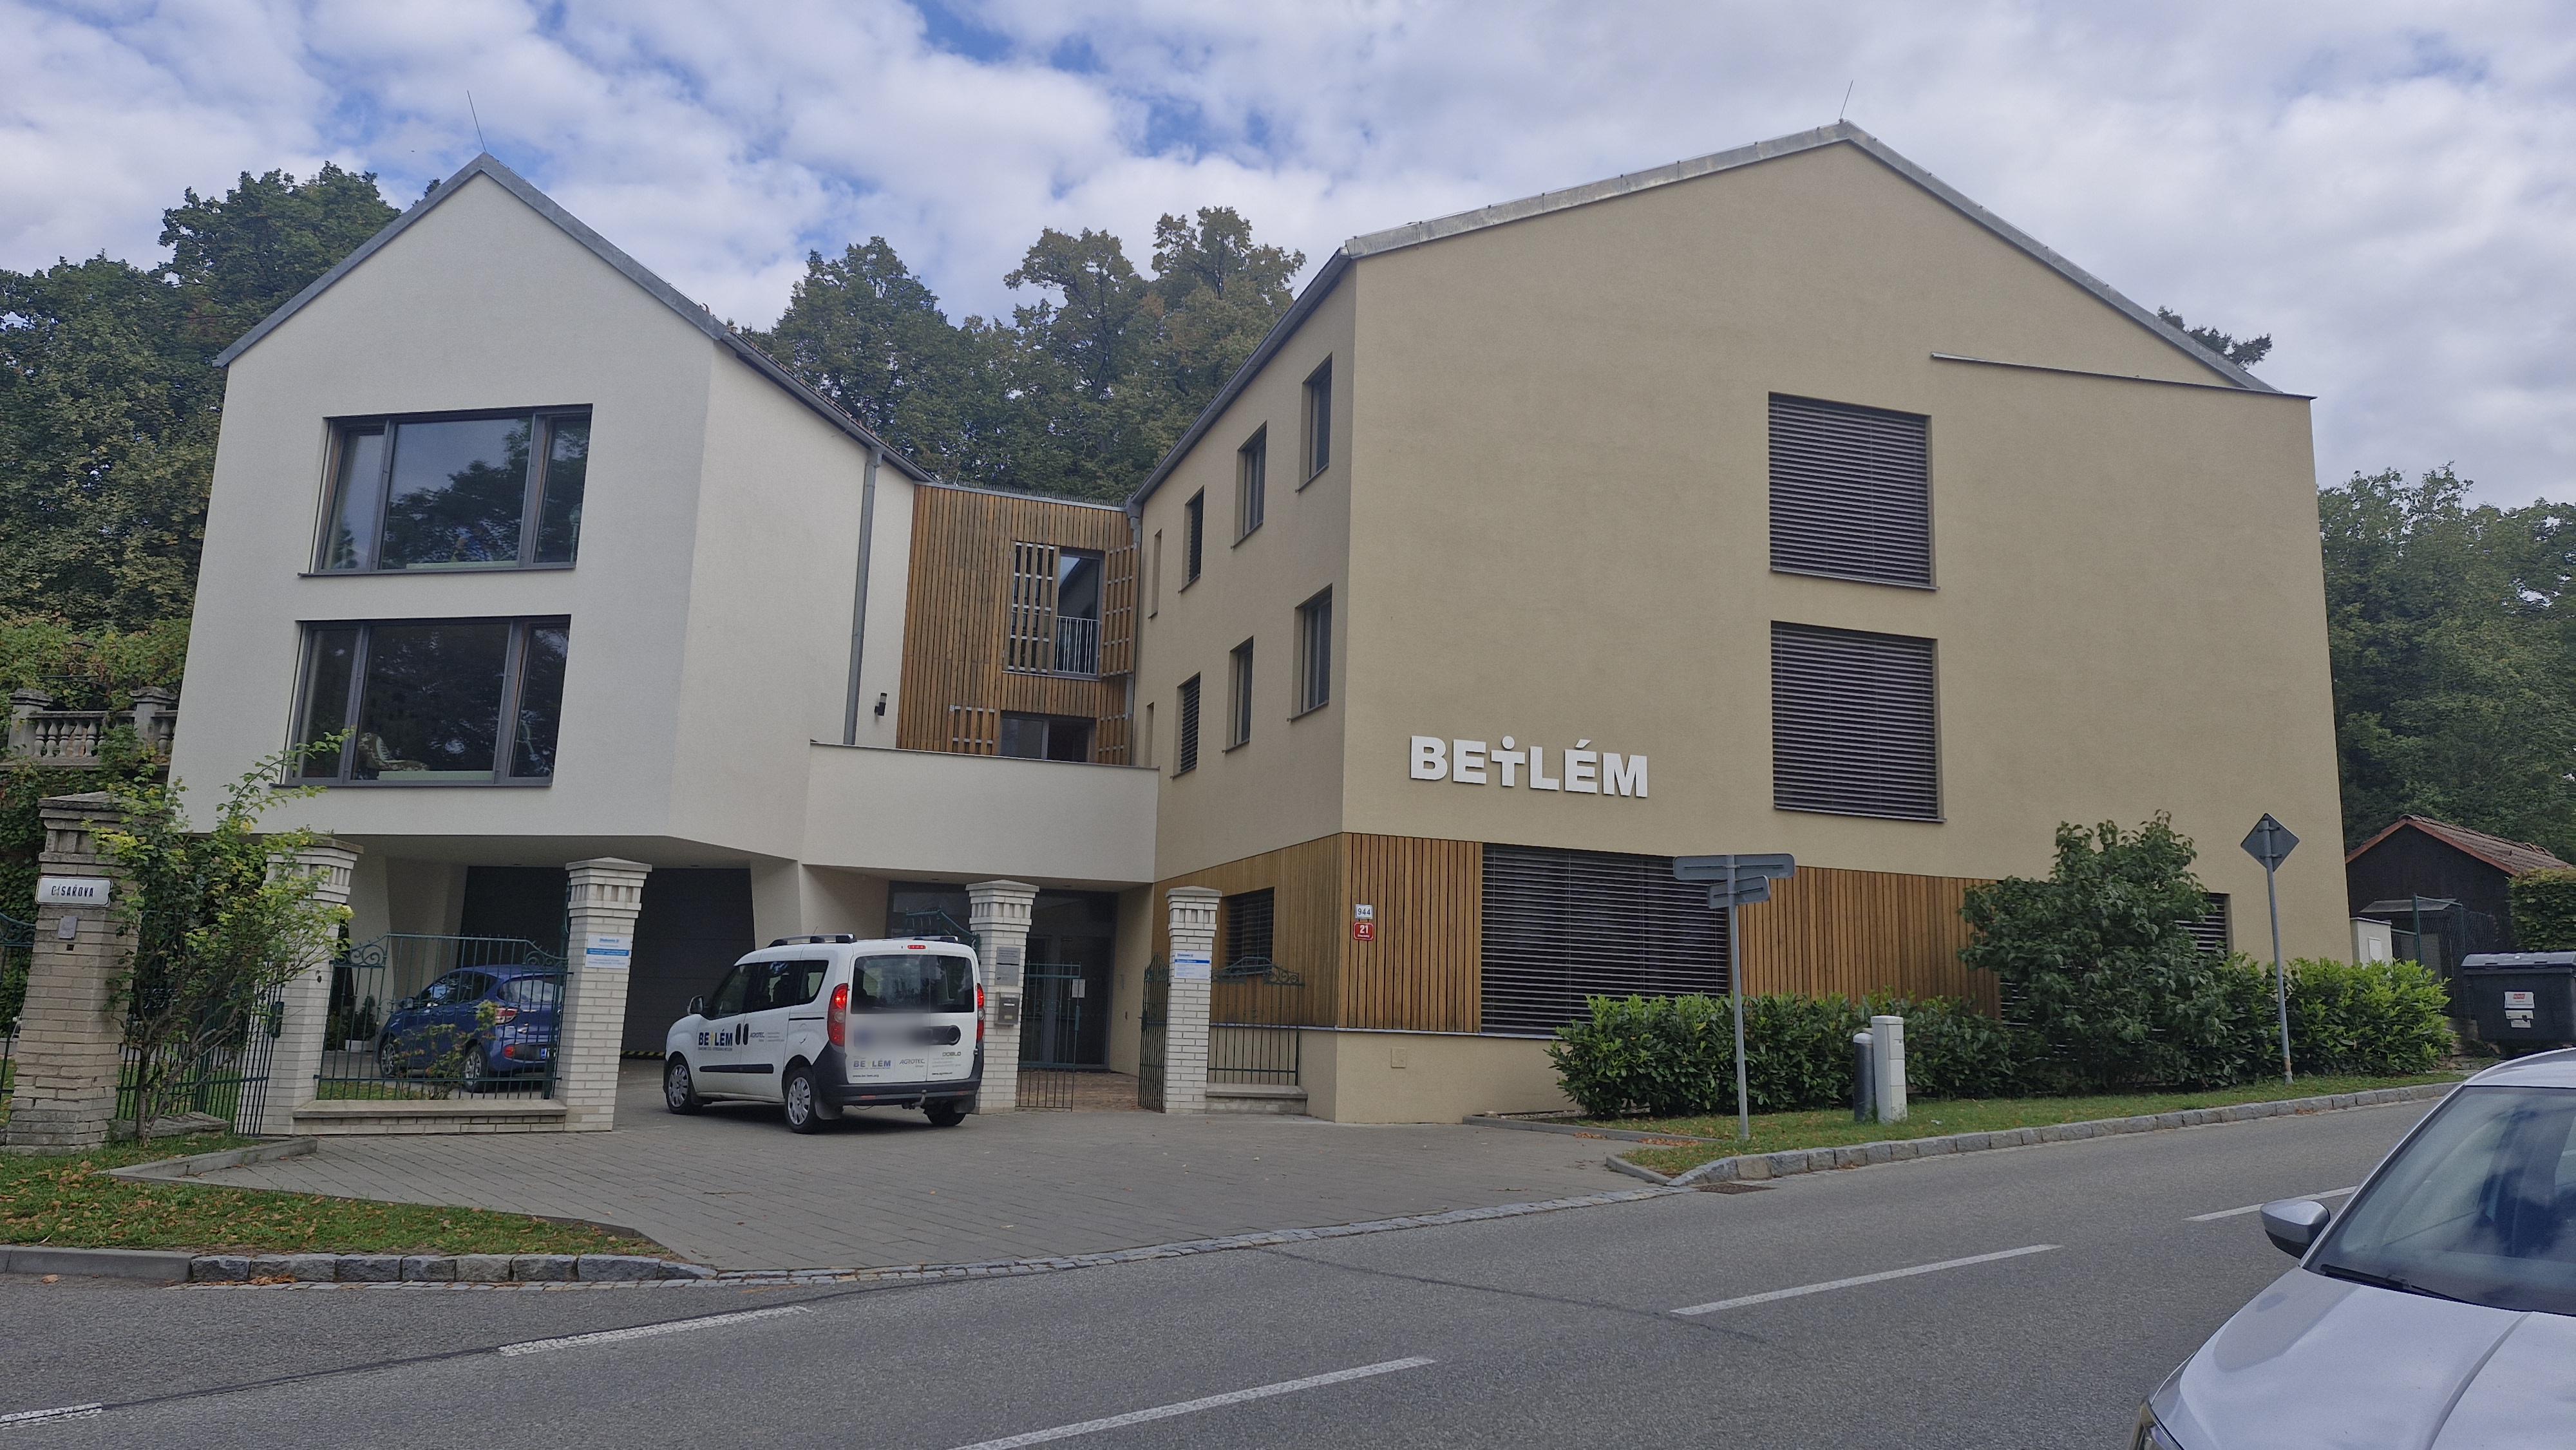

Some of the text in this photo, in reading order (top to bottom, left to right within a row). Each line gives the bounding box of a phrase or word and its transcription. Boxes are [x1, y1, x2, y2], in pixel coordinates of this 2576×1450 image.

[1410, 735, 1648, 798] BETLÉM
[51, 884, 93, 898] CÍSAŘOVA
[1359, 925, 1368, 934] 21
